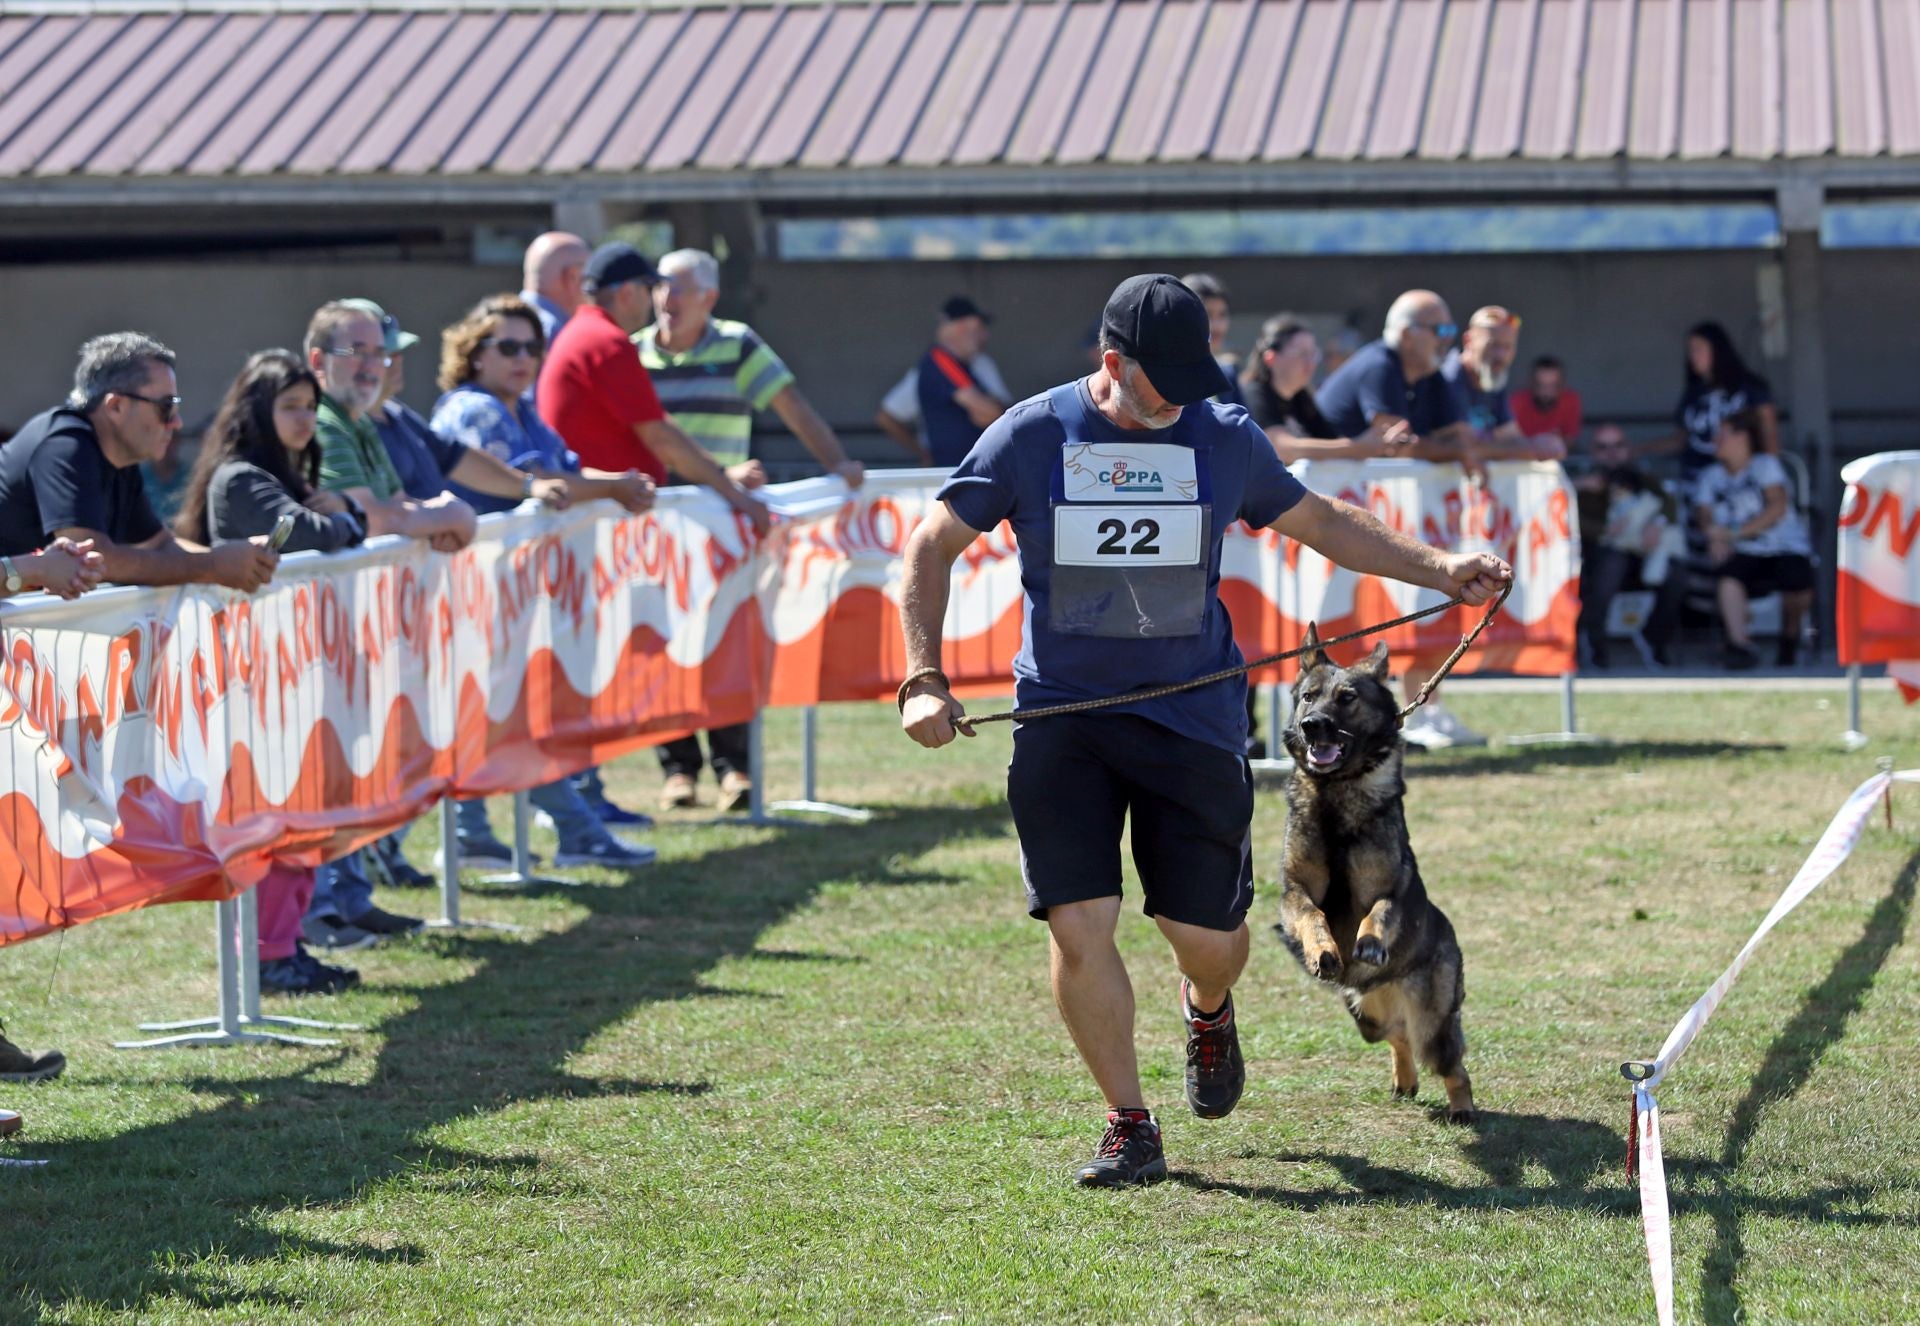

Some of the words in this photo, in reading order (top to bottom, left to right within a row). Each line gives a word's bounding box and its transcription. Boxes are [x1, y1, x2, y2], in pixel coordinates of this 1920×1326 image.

[1097, 518, 1160, 555] 22
[277, 577, 357, 730] ARION
[499, 533, 587, 654] ARION
[593, 512, 691, 637] ARION
